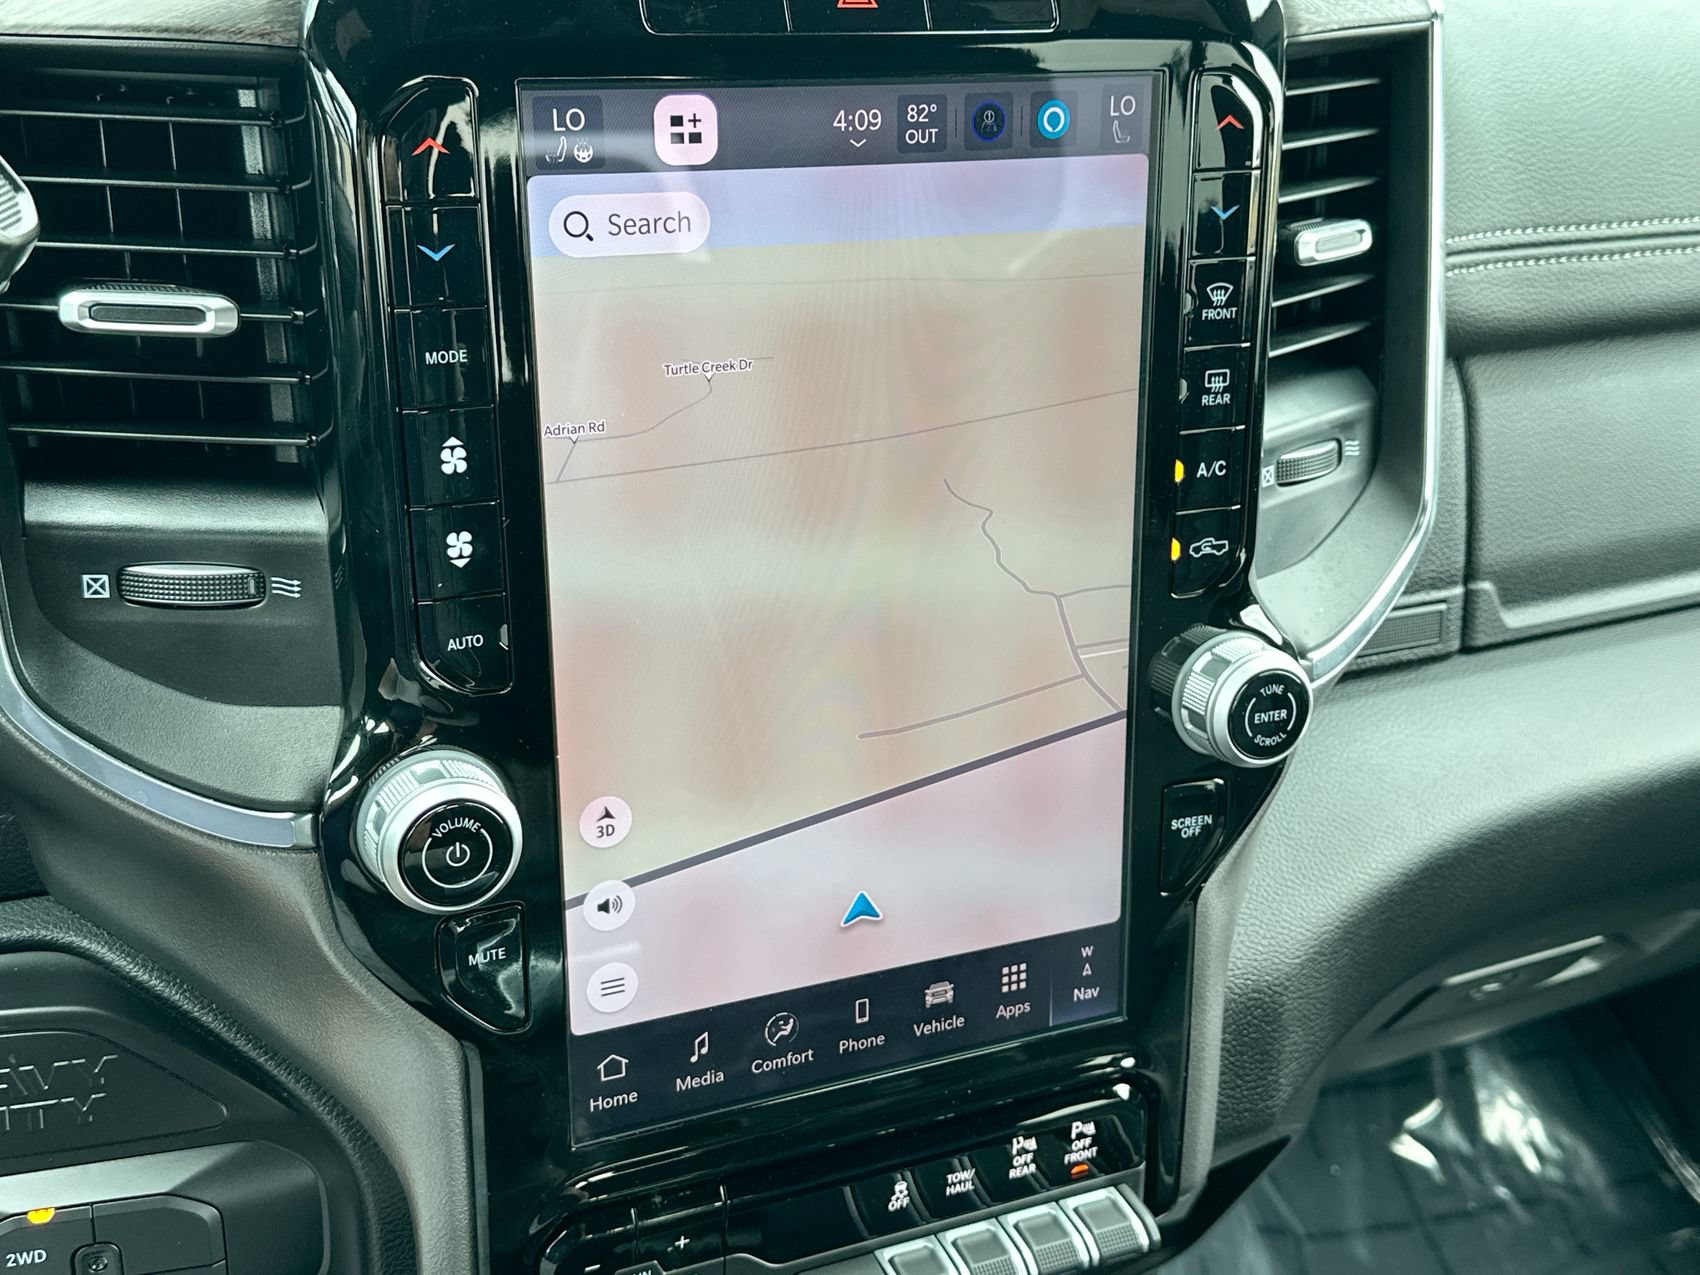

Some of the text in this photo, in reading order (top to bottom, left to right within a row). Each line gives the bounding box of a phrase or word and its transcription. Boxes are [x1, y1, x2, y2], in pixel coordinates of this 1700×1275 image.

[906, 103, 938, 122] 82°
[1110, 95, 1136, 117] LO
[552, 108, 585, 131] LO
[833, 109, 882, 132] 4:09
[905, 128, 939, 145] OUT
[608, 211, 691, 236] Search
[1202, 307, 1238, 321] FRONT
[425, 349, 468, 365] MODE
[664, 359, 753, 376] Turtle Creek Dr
[1201, 393, 1231, 407] REAR
[544, 421, 605, 437] Adrian Rd
[1196, 460, 1227, 478] A/C
[447, 634, 484, 652] AUTO
[1260, 684, 1285, 697] TUNE
[1254, 709, 1288, 724] ENTER
[1253, 732, 1287, 747] SCROLL
[431, 817, 482, 840] VOLUME
[1171, 814, 1213, 830] SCREEN
[596, 824, 615, 838] 3D
[1181, 826, 1202, 838] OFF
[468, 947, 507, 967] MUTE
[1081, 946, 1094, 957] W
[1073, 986, 1100, 1002] Nav
[996, 1001, 1031, 1020] Apps
[913, 1015, 966, 1037] Vehicle
[839, 1033, 886, 1054] Phone
[751, 1049, 814, 1074] Comfort
[676, 1070, 725, 1092] Media
[589, 1091, 639, 1112] Home
[1071, 1138, 1092, 1152] OFF
[1012, 1152, 1034, 1167] OFF
[1064, 1147, 1098, 1164] FRONT
[946, 1168, 976, 1185] TOW/
[1009, 1163, 1037, 1180] REAR
[945, 1180, 975, 1197] HAUL
[888, 1194, 910, 1212] OFF
[5, 1249, 47, 1268] 2WD
